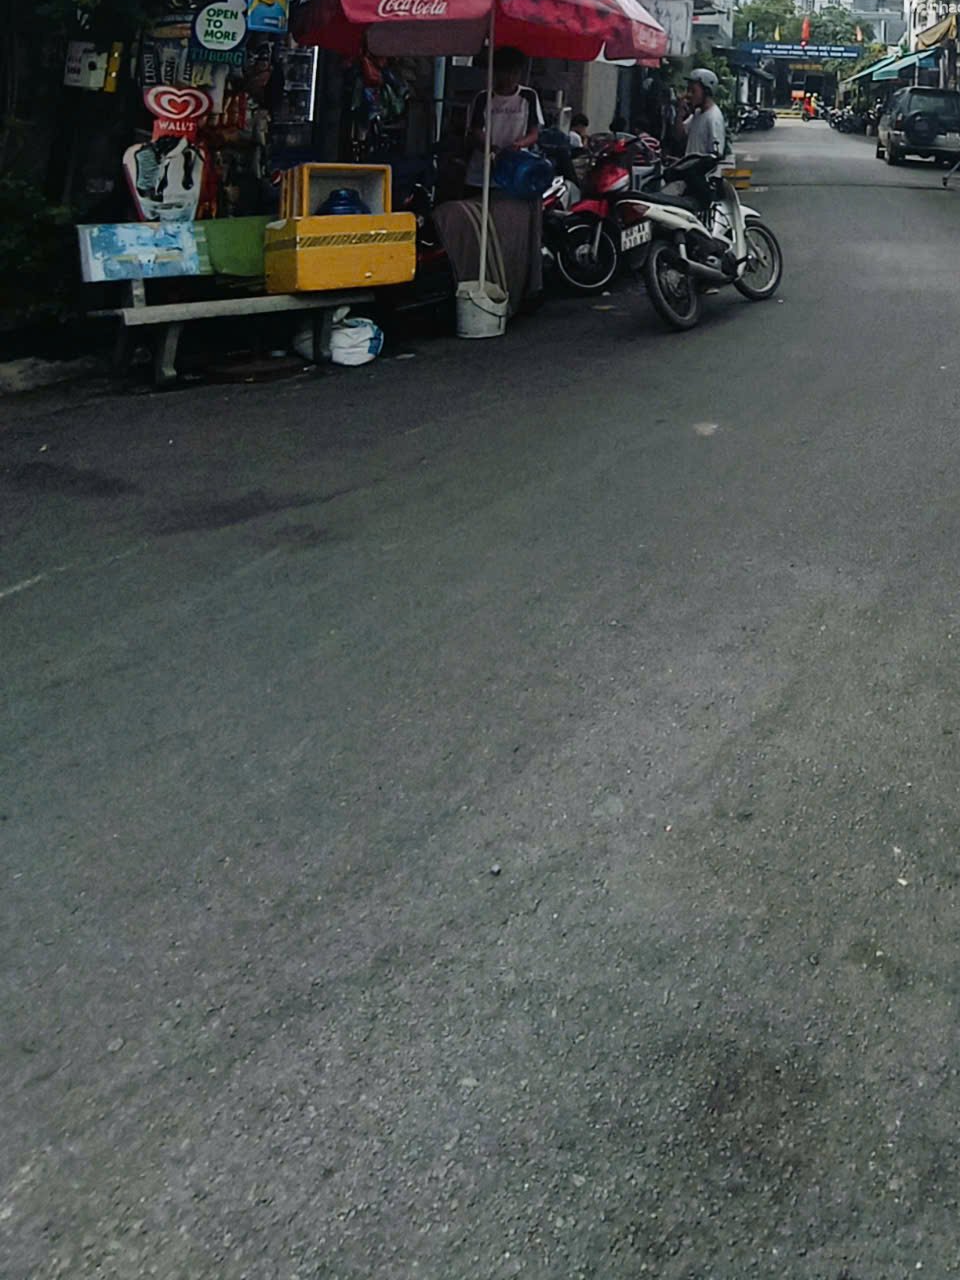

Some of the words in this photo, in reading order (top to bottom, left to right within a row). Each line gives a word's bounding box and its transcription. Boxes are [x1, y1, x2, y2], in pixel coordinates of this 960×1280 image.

[207, 8, 238, 20] OPEN
[207, 19, 223, 29] TO
[204, 30, 237, 41] MORE
[160, 121, 195, 131] WALL'S
